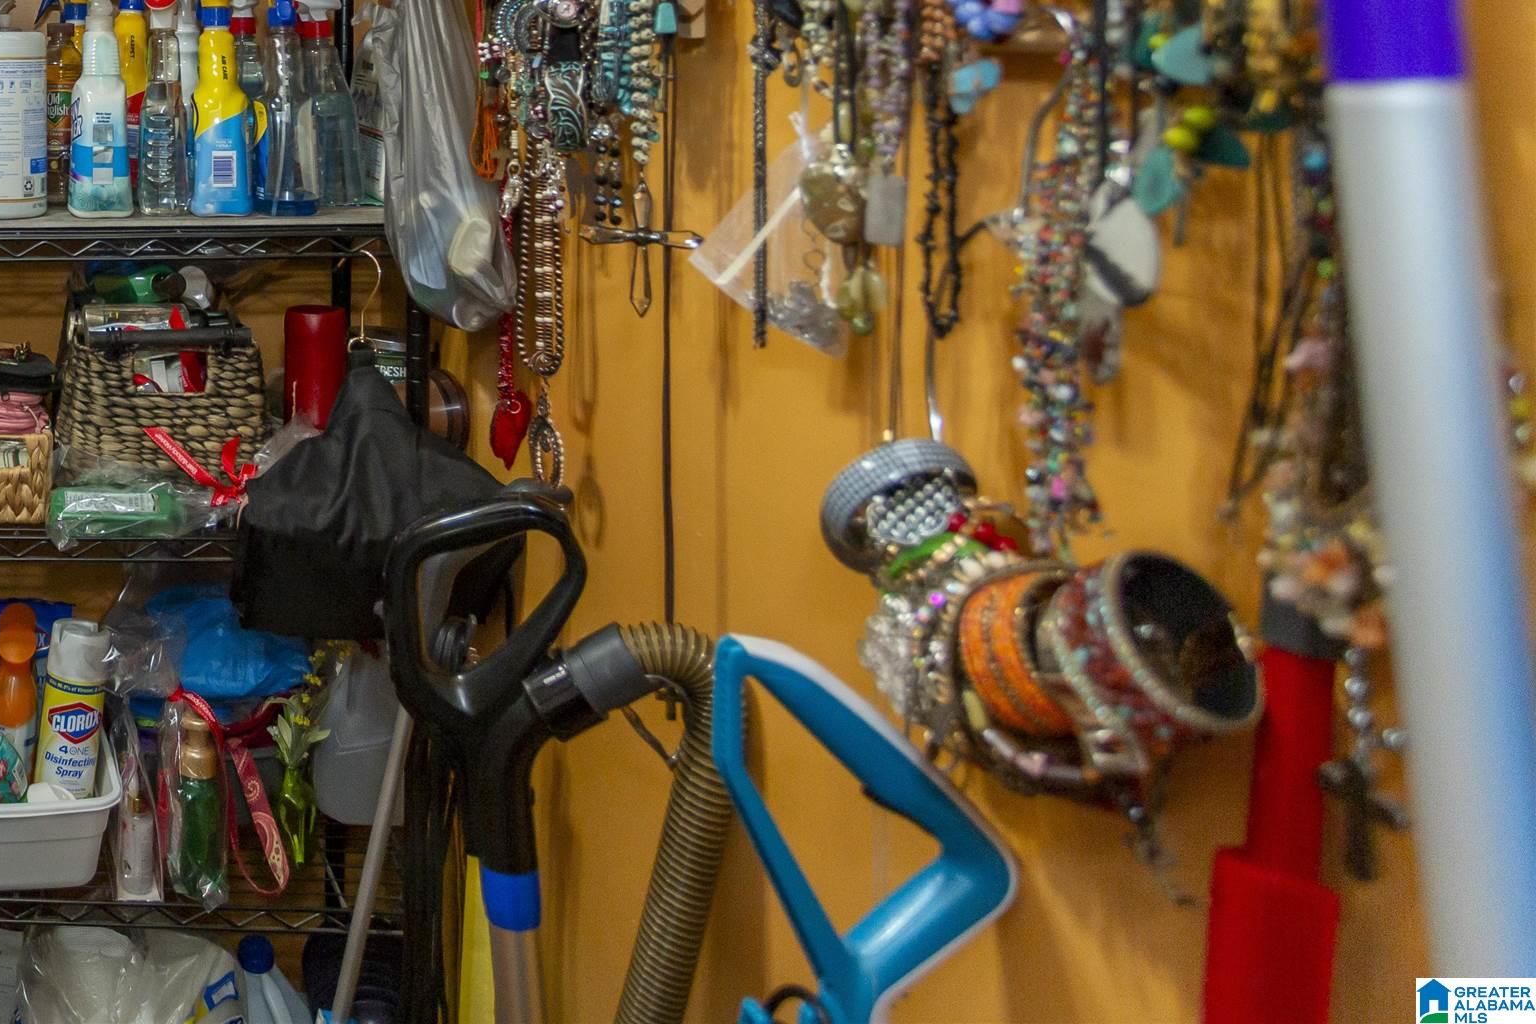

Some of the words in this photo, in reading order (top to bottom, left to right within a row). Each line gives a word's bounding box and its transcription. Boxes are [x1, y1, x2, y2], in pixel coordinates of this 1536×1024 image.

[47, 92, 60, 105] Old
[47, 104, 69, 118] nglish
[374, 364, 407, 378] RESH
[52, 710, 100, 733] CLOROX
[55, 766, 83, 779] Spray
